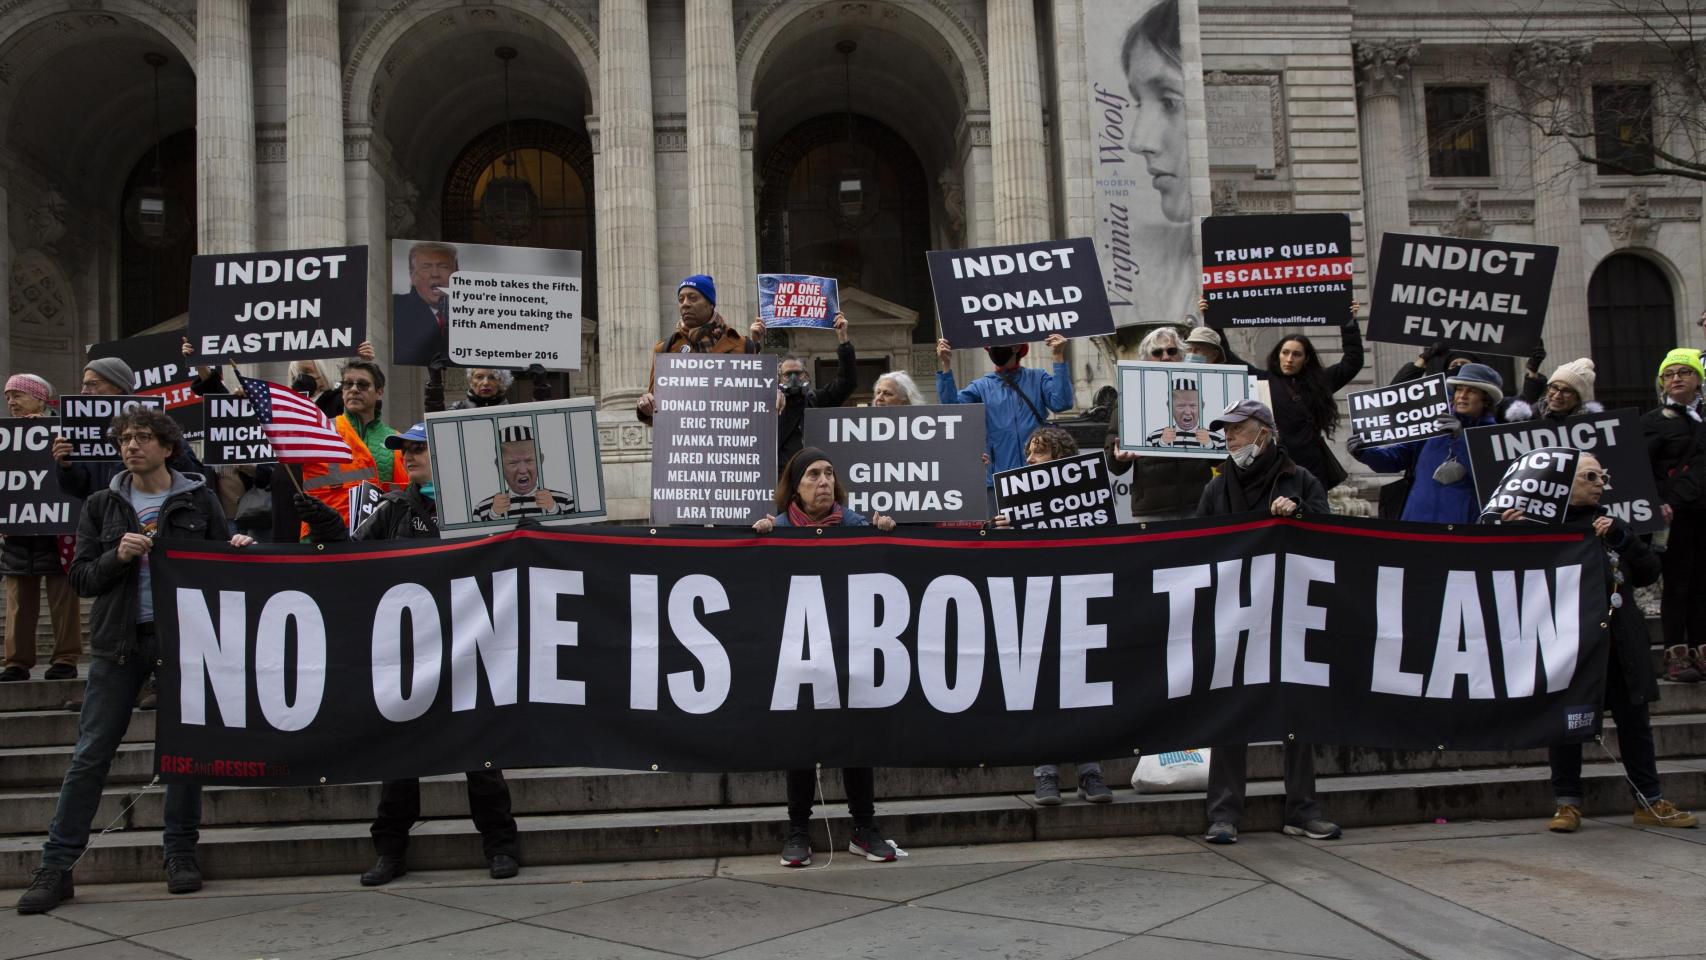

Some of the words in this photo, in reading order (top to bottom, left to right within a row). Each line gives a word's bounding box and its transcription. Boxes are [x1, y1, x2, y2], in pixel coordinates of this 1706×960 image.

[1094, 82, 1130, 166] Woolf
[1096, 179, 1136, 187] MODERN
[1103, 202, 1140, 307] Virginia
[1215, 247, 1274, 261] TRUMP
[1281, 243, 1338, 258] QUEDA
[1402, 240, 1537, 275] INDICT
[215, 254, 347, 286] INDICT
[952, 248, 1074, 280] INDICT
[1201, 262, 1352, 286] DESCALIFICADO
[452, 277, 471, 285] The
[475, 279, 497, 287] mob
[501, 280, 529, 288] takes
[533, 281, 549, 290] the
[553, 283, 578, 291] Fifth.
[777, 282, 796, 295] NO
[797, 283, 821, 297] ONE
[1210, 292, 1223, 300] DE
[1243, 288, 1282, 297] BOLETA
[1286, 284, 1346, 294] ELECTORAL
[453, 291, 460, 299] If
[463, 293, 496, 301] you're
[500, 293, 547, 305] innocent,
[773, 294, 788, 306] IS
[788, 295, 827, 308] ABOVE
[961, 286, 1082, 314] DONALD
[1391, 284, 1527, 318] MICHAEL
[235, 299, 320, 322] JOHN
[452, 305, 474, 316] why
[498, 309, 516, 317] you
[520, 309, 553, 320] taking
[556, 311, 572, 319] the
[776, 305, 799, 318] THE
[800, 306, 828, 319] LAW
[1231, 315, 1327, 327] TrumpIsDisqualified.org
[453, 319, 476, 328] Fifth
[480, 319, 551, 331] Amendment?
[974, 311, 1080, 338] TRUMP
[1403, 315, 1504, 344] FLYNN
[202, 328, 351, 355] EASTMAN
[452, 348, 472, 358] -DJT
[475, 349, 532, 359] September
[535, 351, 558, 359] 2016
[671, 359, 725, 369] INDICT
[730, 360, 762, 370] THE
[133, 362, 179, 391] UMP
[658, 377, 708, 386] CRIME
[714, 377, 773, 387] FAMILY
[1354, 379, 1440, 411] INDICT
[210, 398, 256, 418] IND
[662, 400, 705, 411] DONALD
[710, 401, 749, 411] TRUMP
[753, 402, 769, 412] JR.
[1352, 414, 1391, 429] THE
[1395, 402, 1448, 424] COUP
[62, 426, 101, 440] THE
[210, 425, 267, 442] MICH
[681, 417, 706, 428] ERIC
[710, 418, 749, 429] TRUMP
[829, 416, 962, 442] INDICT
[1360, 420, 1442, 444] LEADERS
[69, 442, 117, 457] LEAD
[672, 435, 713, 446] IVANKA
[717, 435, 757, 447] TRUMP
[1490, 418, 1621, 462] INDICT
[668, 453, 703, 464] JARED
[707, 453, 759, 464] KUSHNER
[1503, 452, 1574, 479] DICT
[0, 469, 49, 491] DY
[668, 471, 716, 482] MELANIA
[720, 471, 760, 482] TRUMP
[850, 462, 939, 483] GINNI
[1000, 458, 1100, 497] INDICT
[654, 488, 711, 500] KIMBERLY
[715, 489, 774, 500] GUILFOYLE
[1505, 478, 1569, 499] COUP
[848, 488, 965, 514] HOMAS
[1000, 501, 1044, 522] THE
[1049, 488, 1110, 513] COUP
[1487, 495, 1557, 518] ADERS
[677, 507, 706, 518] LARA
[710, 507, 750, 518] TRUMP
[1021, 509, 1108, 529] ADERS
[177, 588, 326, 731] NO
[372, 567, 585, 721] ONE
[630, 574, 731, 714] IS
[770, 573, 1113, 713] ABOVE
[1153, 553, 1335, 698] THE
[1371, 564, 1582, 699] LAW
